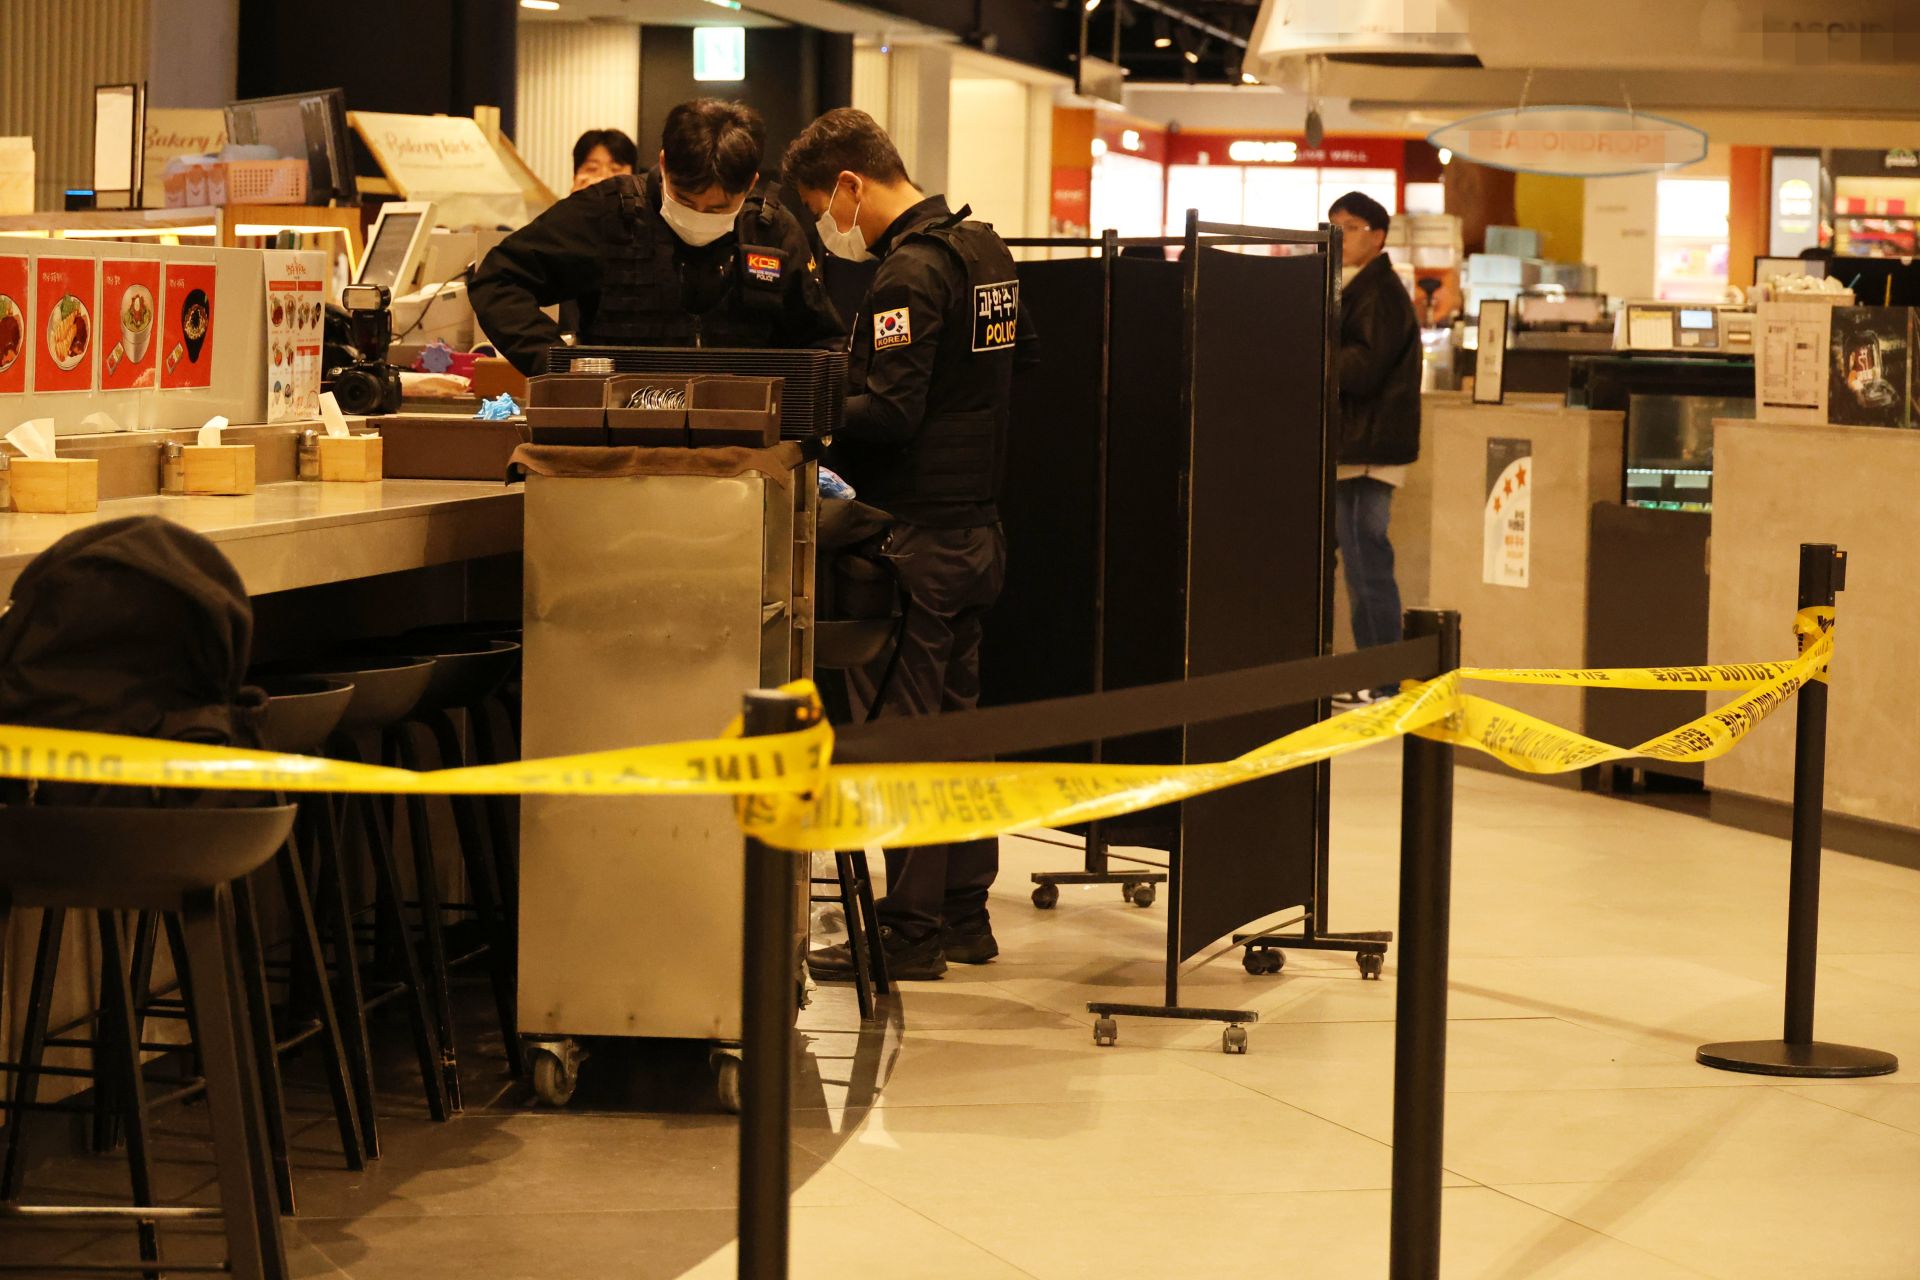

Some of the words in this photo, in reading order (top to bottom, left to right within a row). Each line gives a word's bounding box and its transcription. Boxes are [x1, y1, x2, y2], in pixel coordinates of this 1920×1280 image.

[756, 274, 774, 282] POLICE
[979, 287, 1017, 320] 과학수
[877, 335, 908, 347] KOREA
[986, 320, 1017, 346] POLIC
